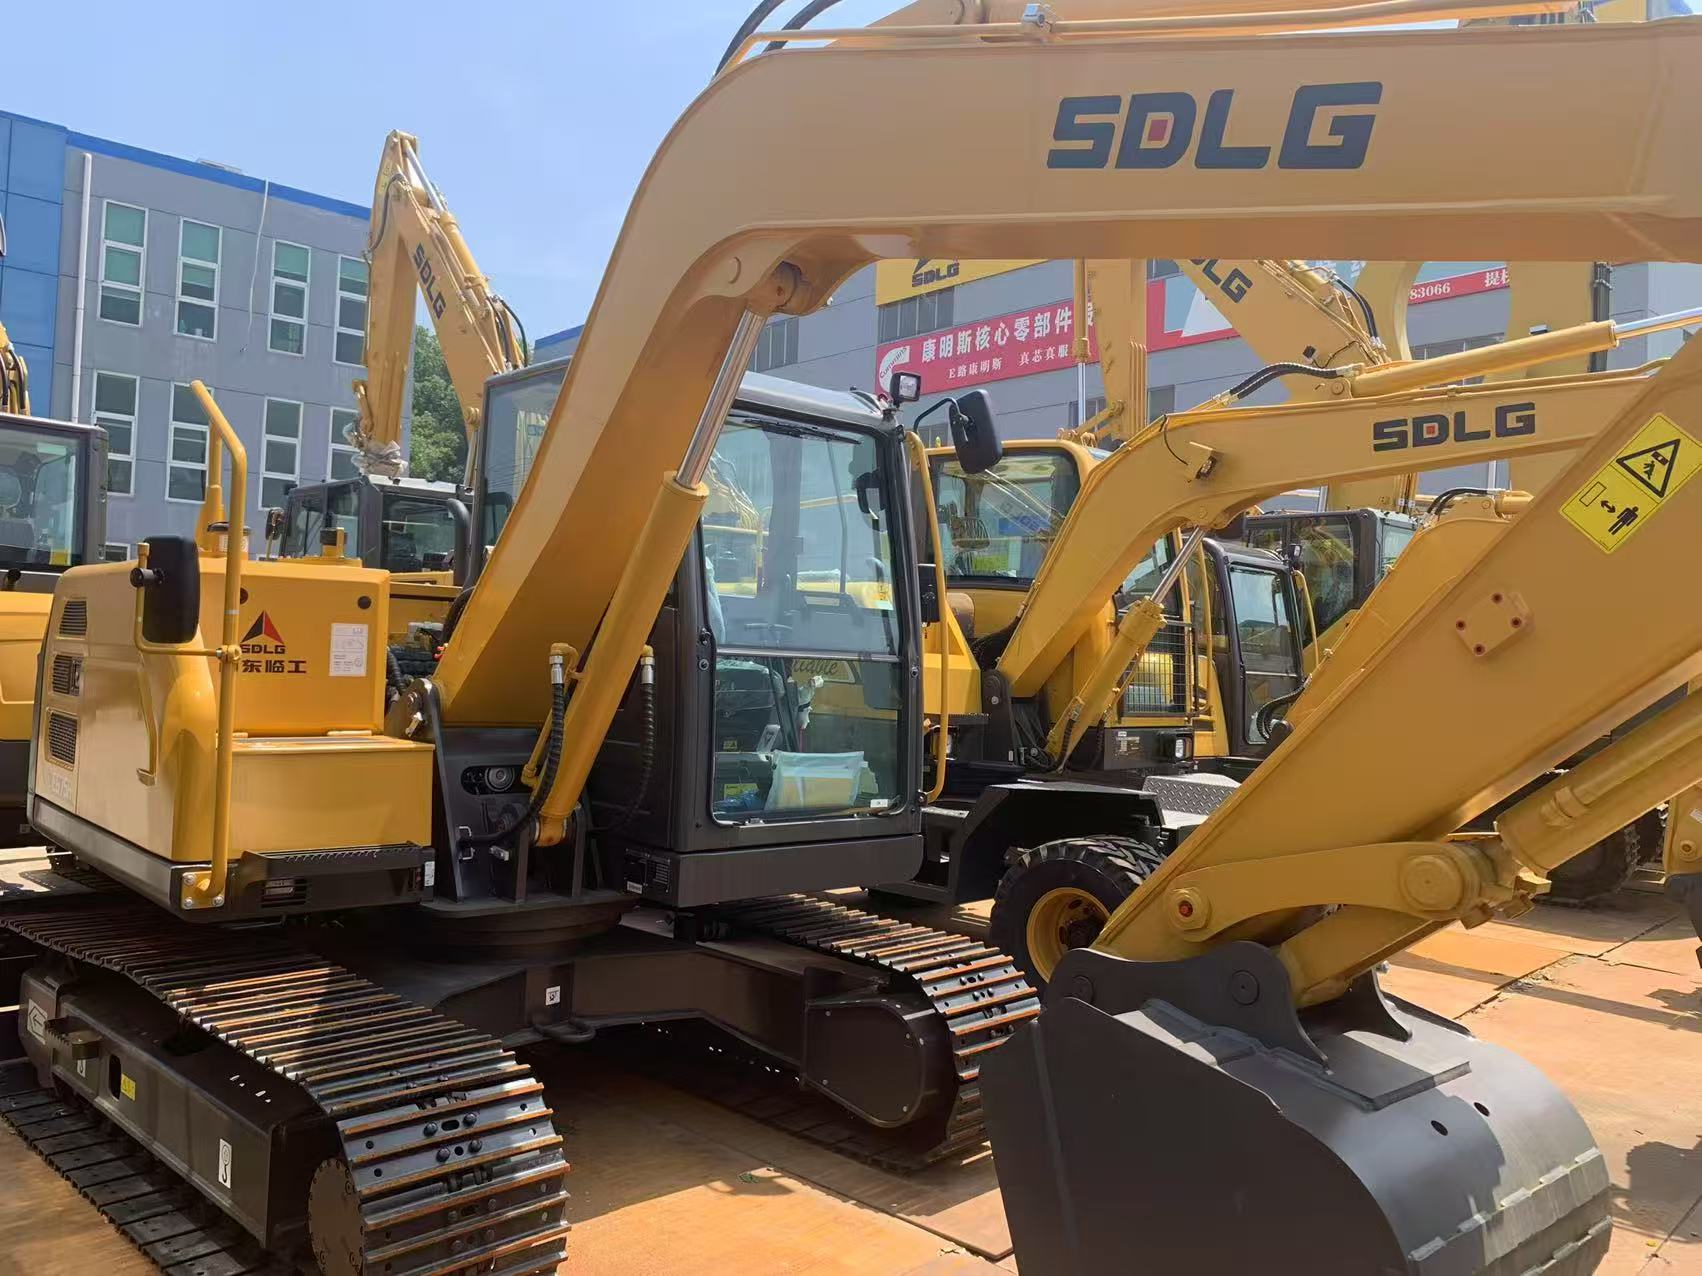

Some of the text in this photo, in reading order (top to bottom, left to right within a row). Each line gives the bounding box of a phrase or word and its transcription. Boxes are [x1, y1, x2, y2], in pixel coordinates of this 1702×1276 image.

[1047, 81, 1382, 169] SDLG
[413, 243, 446, 319] SDLG
[911, 263, 959, 287] SDLG
[1189, 260, 1253, 303] LG
[1408, 282, 1451, 300] 83066
[1373, 402, 1535, 451] SDLG
[240, 644, 286, 655] SDLG
[237, 659, 307, 674] 东临工
